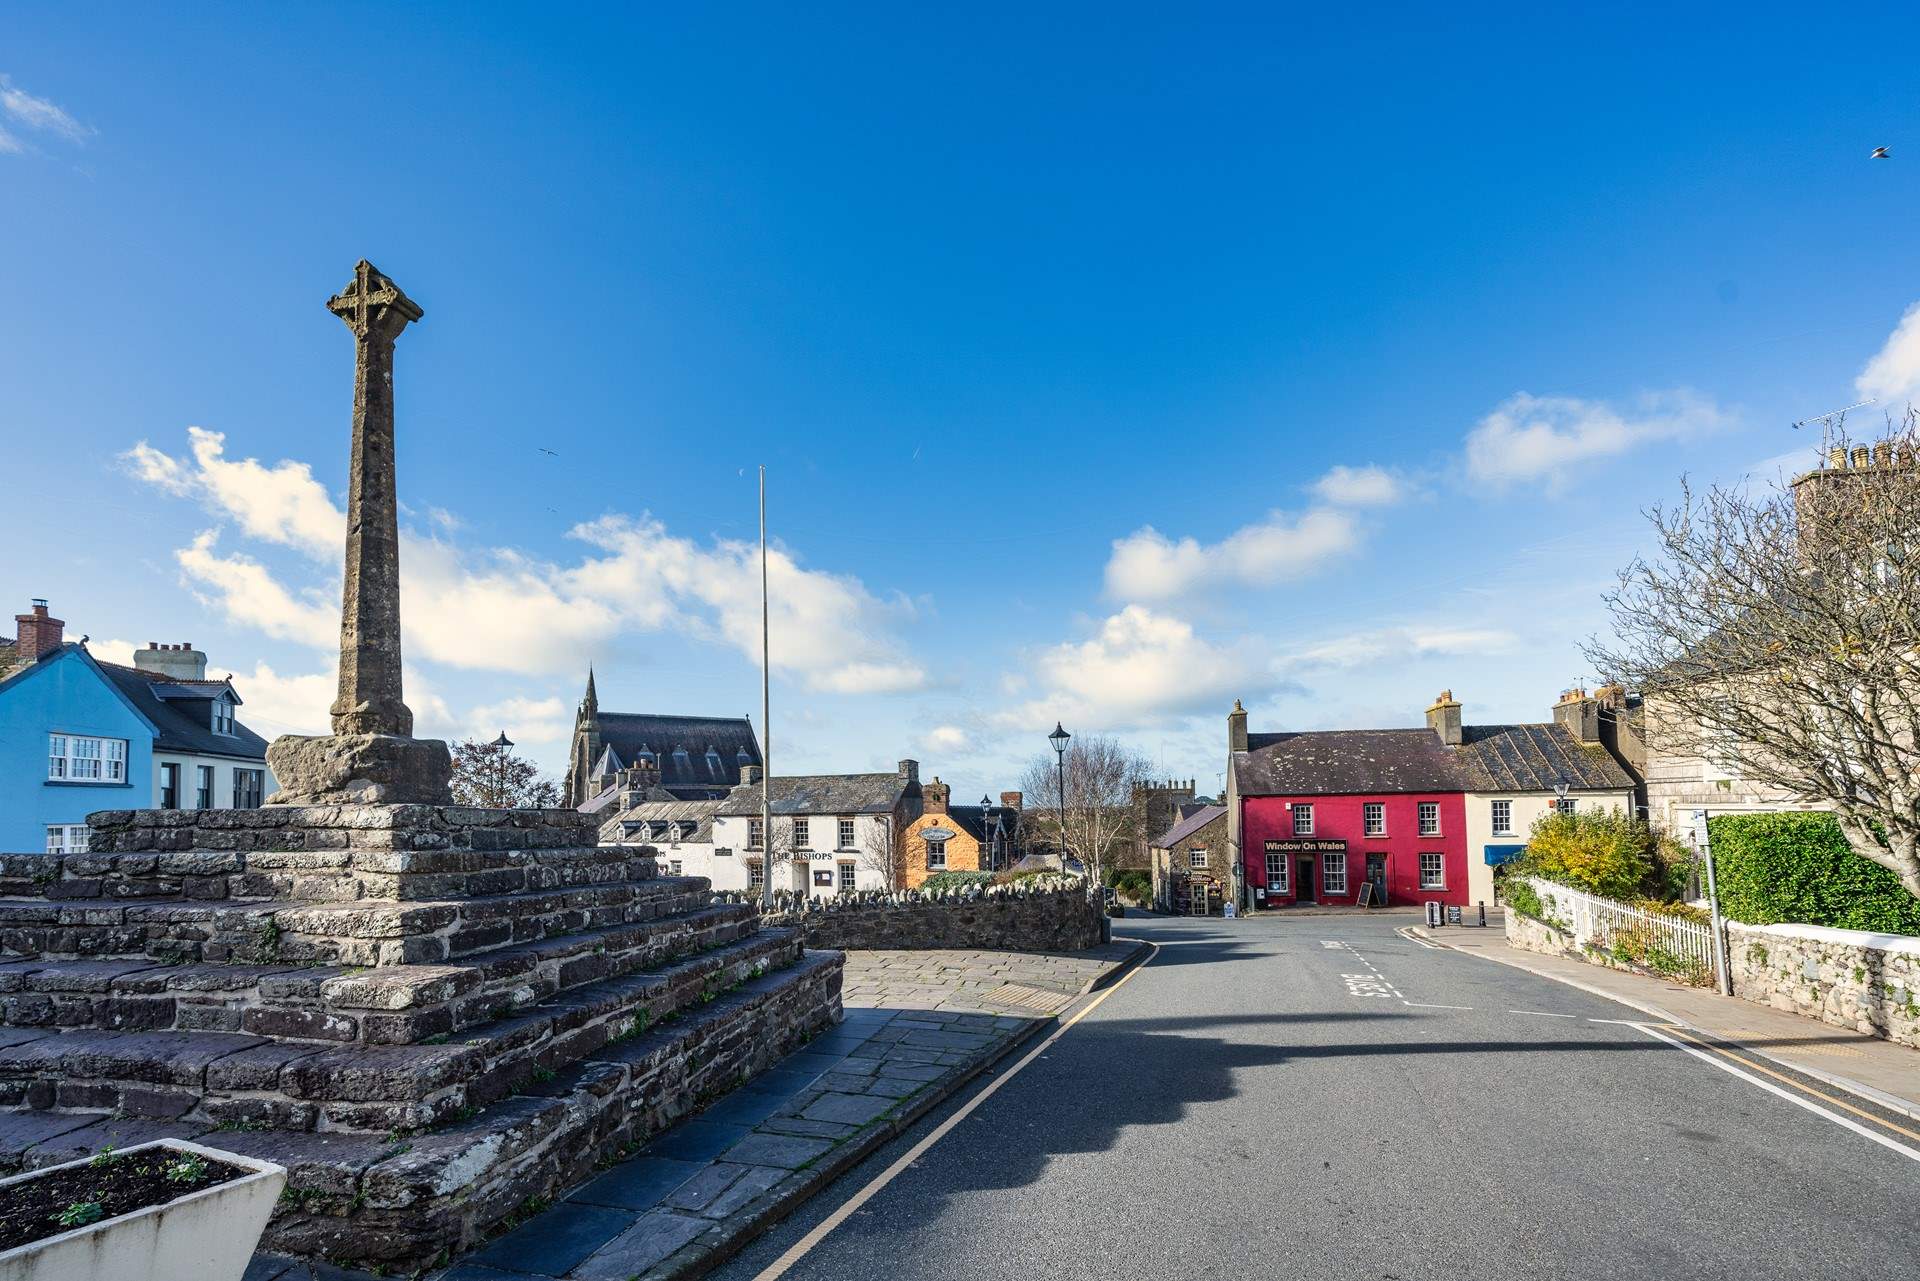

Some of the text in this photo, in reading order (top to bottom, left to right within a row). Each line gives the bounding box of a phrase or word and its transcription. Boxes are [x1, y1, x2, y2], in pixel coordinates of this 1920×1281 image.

[1265, 842, 1346, 850] Window On Wales
[772, 852, 833, 861] THE BISHOPS
